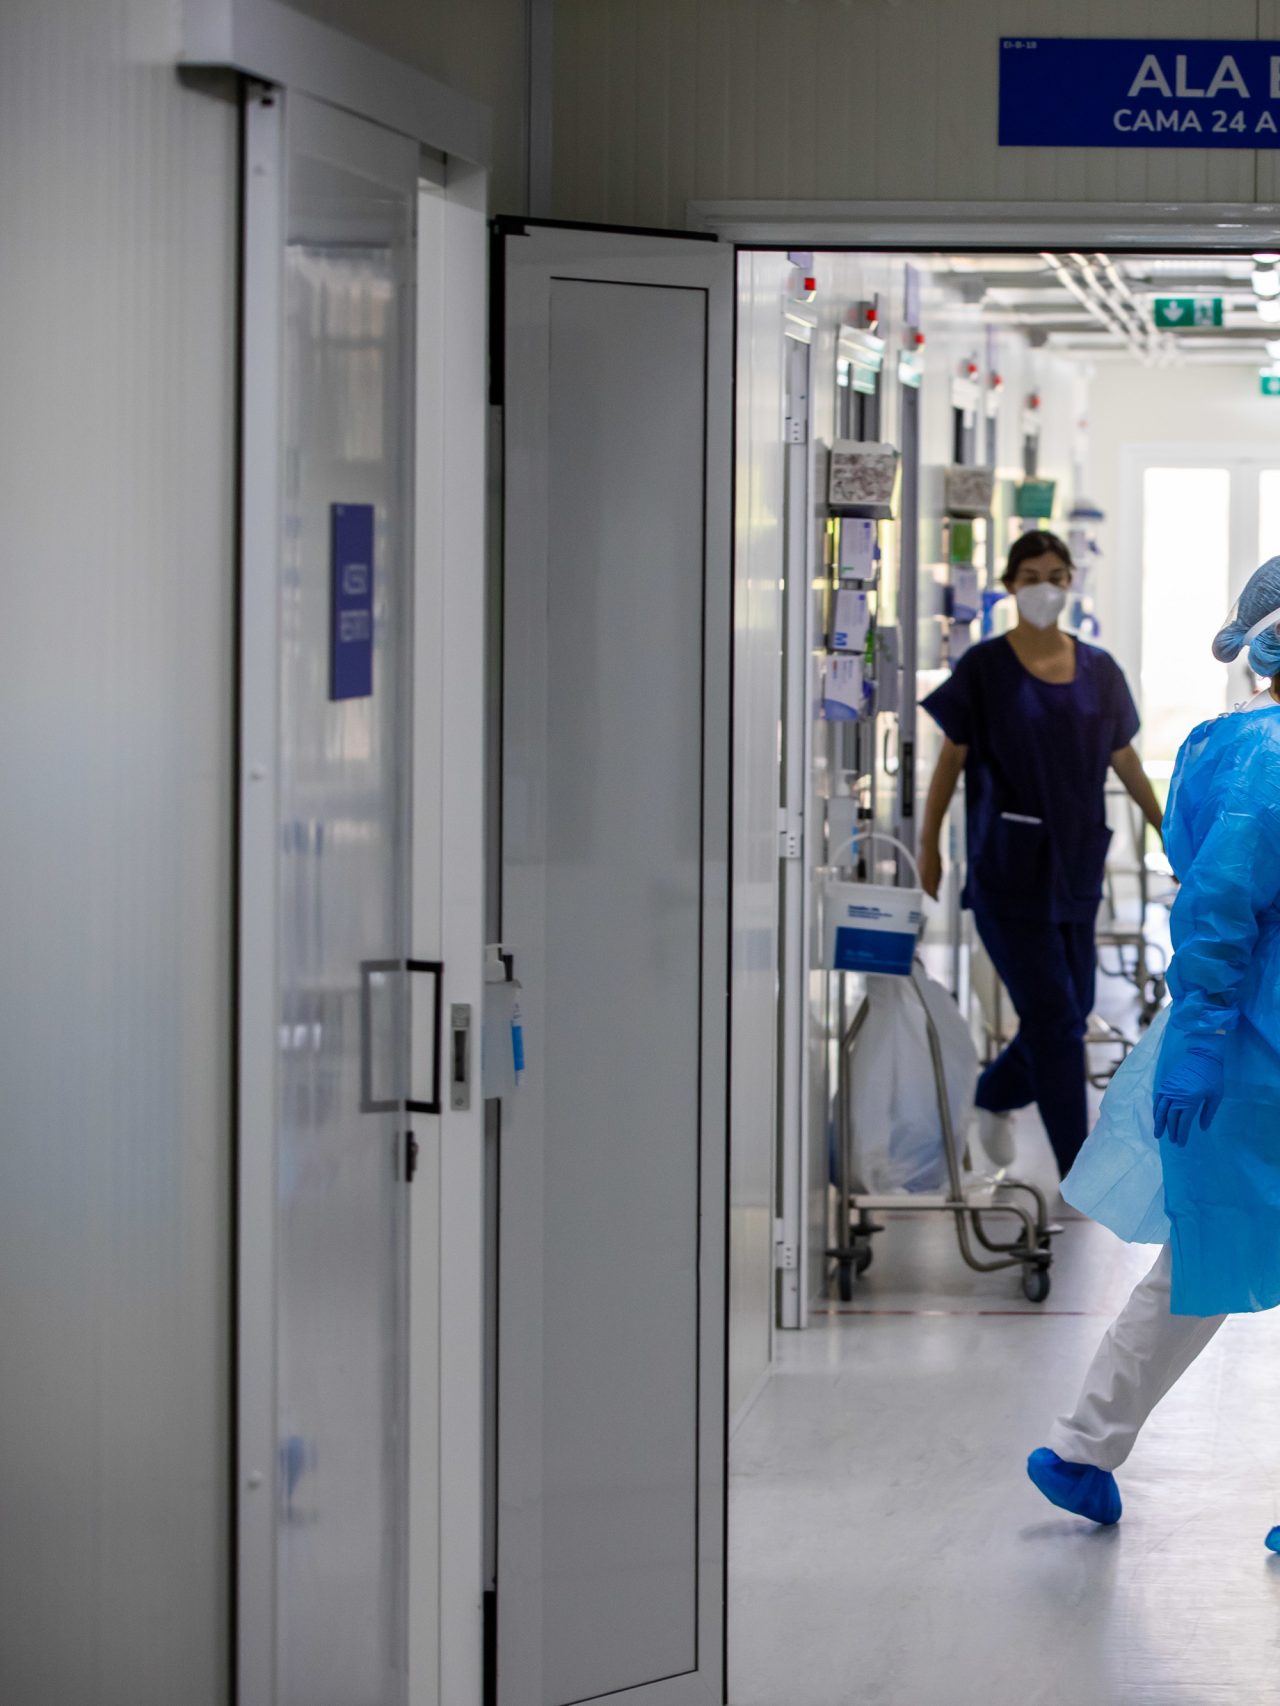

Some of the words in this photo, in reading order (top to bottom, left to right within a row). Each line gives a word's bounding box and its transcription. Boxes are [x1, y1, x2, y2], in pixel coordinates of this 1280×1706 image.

[1127, 54, 1251, 99] ALA
[1113, 108, 1203, 133] CAMA
[1211, 110, 1246, 133] 24
[1254, 111, 1277, 134] A
